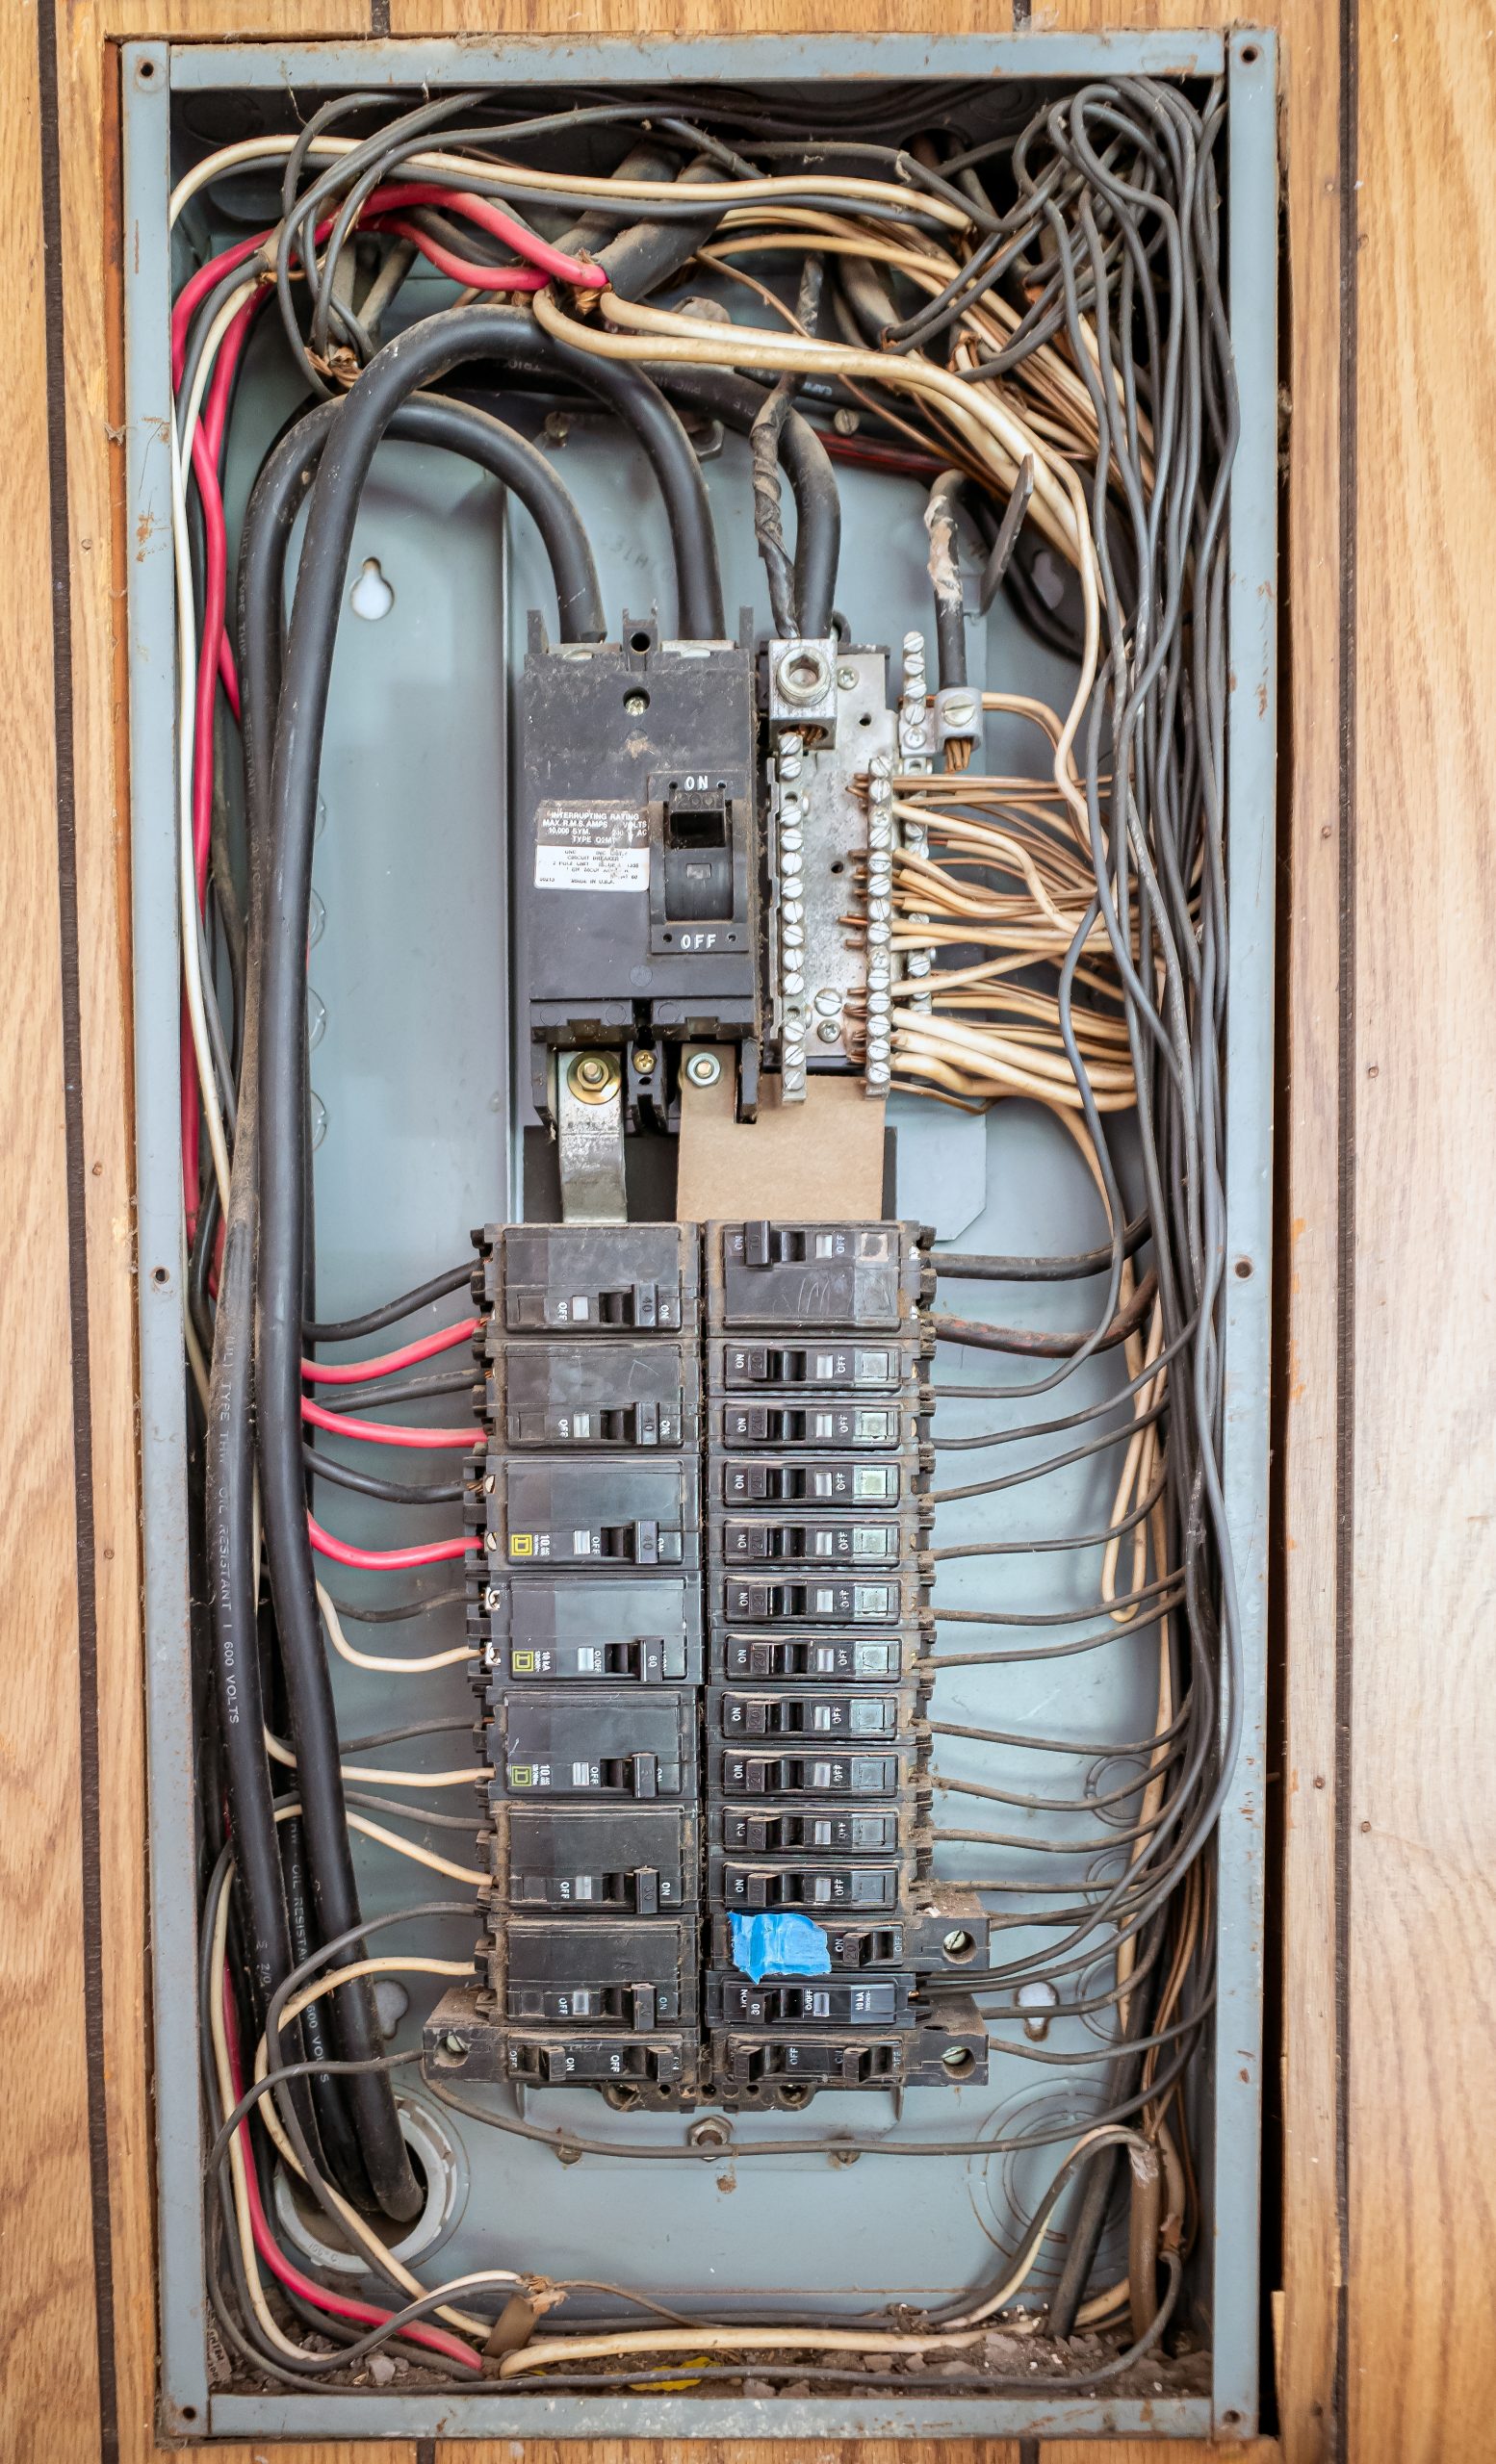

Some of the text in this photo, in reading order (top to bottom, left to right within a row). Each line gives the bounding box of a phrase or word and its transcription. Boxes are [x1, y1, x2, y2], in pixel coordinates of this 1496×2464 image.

[684, 776, 709, 790] ON
[681, 934, 716, 950] OFF
[735, 1235, 743, 1250] ON
[836, 1235, 845, 1253] OFF
[557, 1302, 568, 1322] OFF
[660, 1304, 669, 1320] ON
[735, 1353, 745, 1369] ON
[838, 1354, 846, 1373] OFF
[219, 1381, 232, 1422] TYPE
[558, 1419, 569, 1438] OFF
[660, 1420, 670, 1435] ON
[736, 1417, 747, 1432] ON
[838, 1415, 849, 1433] OFF
[735, 1475, 744, 1489] ON
[836, 1473, 845, 1491] OFF
[592, 1536, 601, 1554] OFF
[737, 1534, 747, 1549] ON
[838, 1531, 849, 1551] OFF
[219, 1524, 232, 1610] RESISTANT
[739, 1592, 748, 1606] ON
[839, 1590, 849, 1608] OFF
[223, 1641, 234, 1667] 600
[647, 1655, 658, 1668] 60
[737, 1649, 747, 1663] ON
[838, 1649, 848, 1666] OFF
[226, 1675, 240, 1724] VOLTS
[732, 1707, 741, 1721] ON
[832, 1707, 841, 1724] OFF
[590, 1766, 599, 1784] OFF
[734, 1765, 743, 1779] ON
[833, 1764, 843, 1782] OFF
[736, 1823, 745, 1837] ON
[559, 1882, 570, 1900] OFF
[661, 1882, 670, 1897] ON
[735, 1879, 744, 1892] ON
[836, 1879, 844, 1897] OFF
[835, 1938, 844, 1952] ON
[558, 1997, 568, 2015] OFF
[658, 1997, 667, 2011] ON
[751, 2003, 761, 2015] 30
[306, 2005, 329, 2083] 600 VOLS
[566, 2058, 575, 2072] ON
[609, 2055, 620, 2073] OFF
[789, 2048, 798, 2066] OFF
